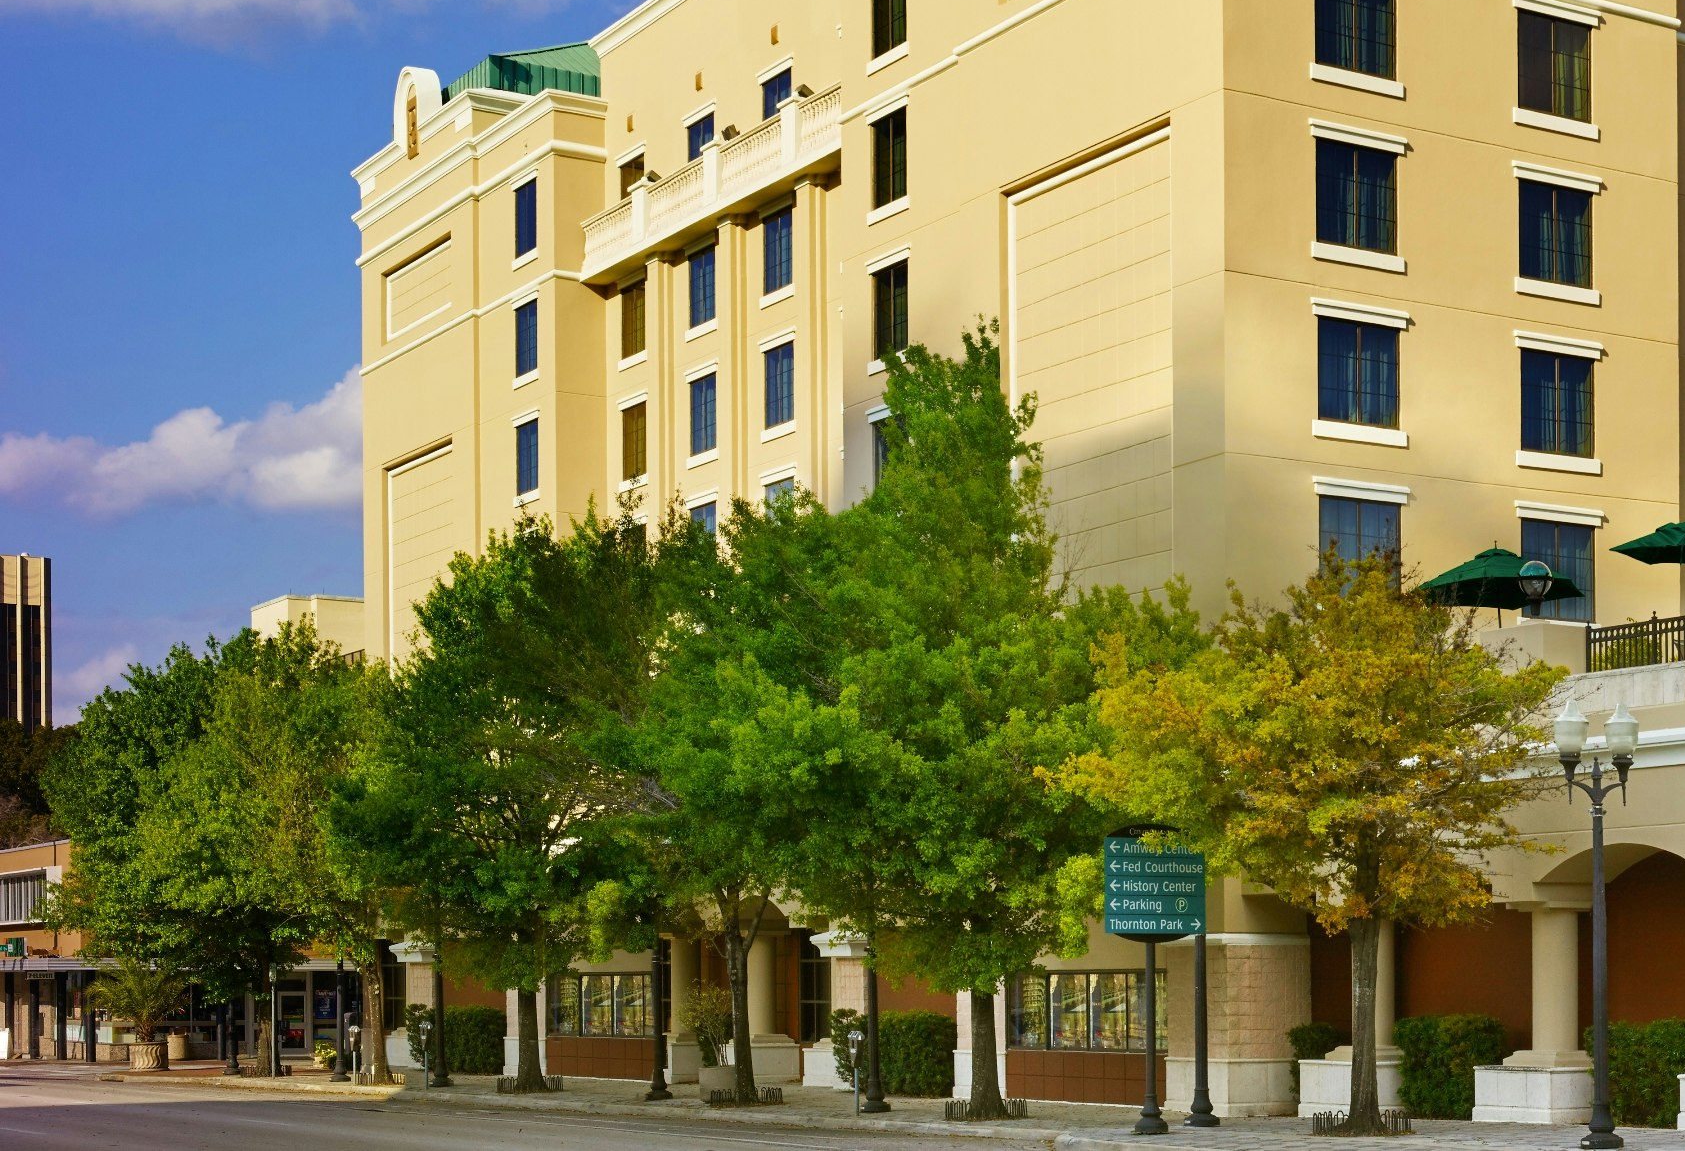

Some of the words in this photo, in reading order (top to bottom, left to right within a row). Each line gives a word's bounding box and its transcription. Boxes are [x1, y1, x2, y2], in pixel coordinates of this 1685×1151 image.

[1165, 843, 1198, 855] Cente
[1123, 861, 1141, 872] Fed
[1145, 861, 1203, 874] Courthouse
[1123, 879, 1159, 895] History
[1162, 881, 1197, 892] Center
[1123, 898, 1162, 913] Parking
[1110, 919, 1156, 930] Thornton
[1160, 919, 1183, 930] Park
